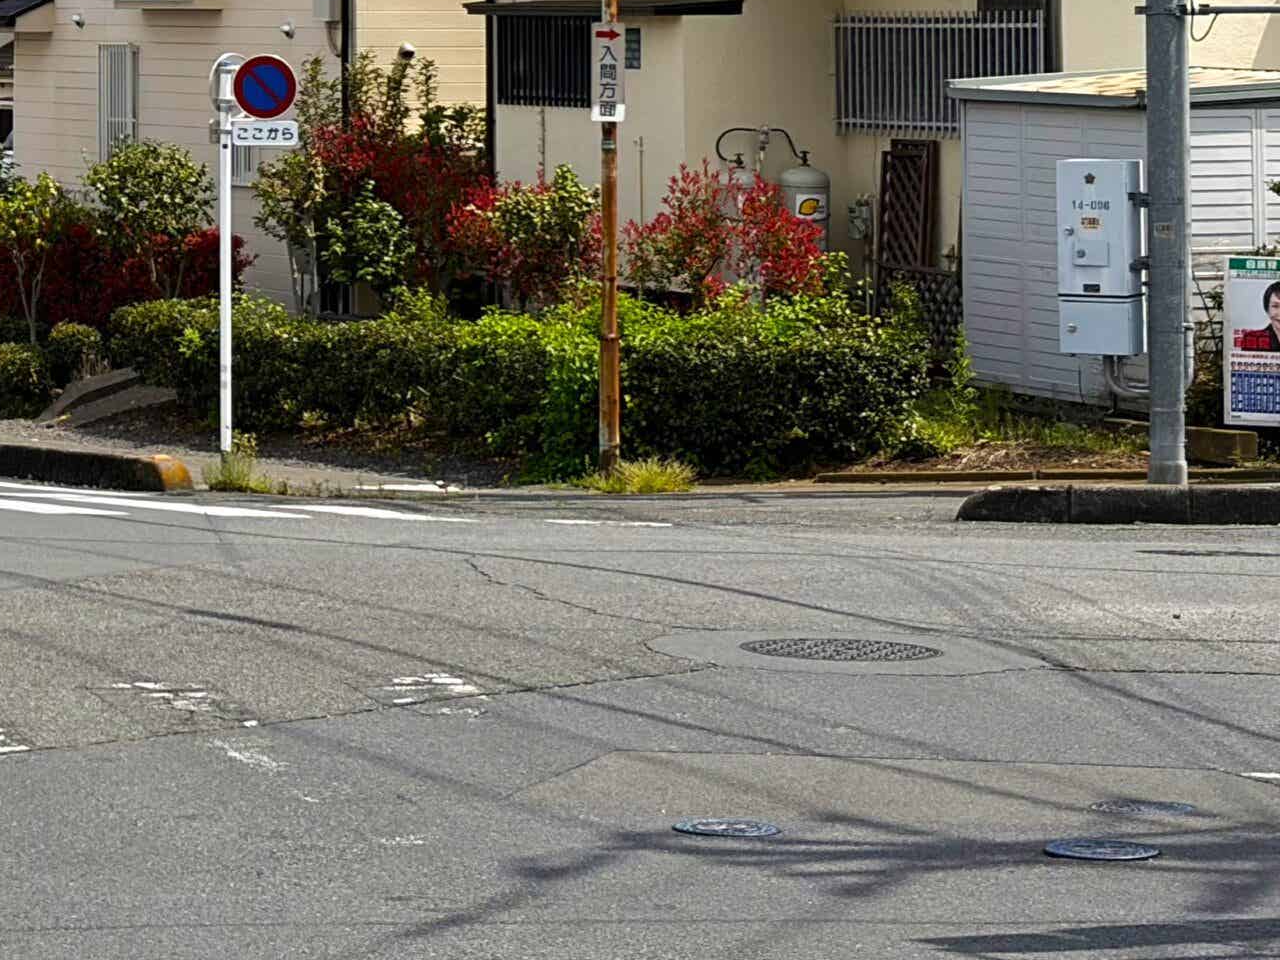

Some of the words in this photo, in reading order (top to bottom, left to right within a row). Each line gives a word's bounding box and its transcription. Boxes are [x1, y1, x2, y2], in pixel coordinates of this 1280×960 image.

[599, 45, 618, 116] 入間方面
[237, 127, 294, 141] ここから
